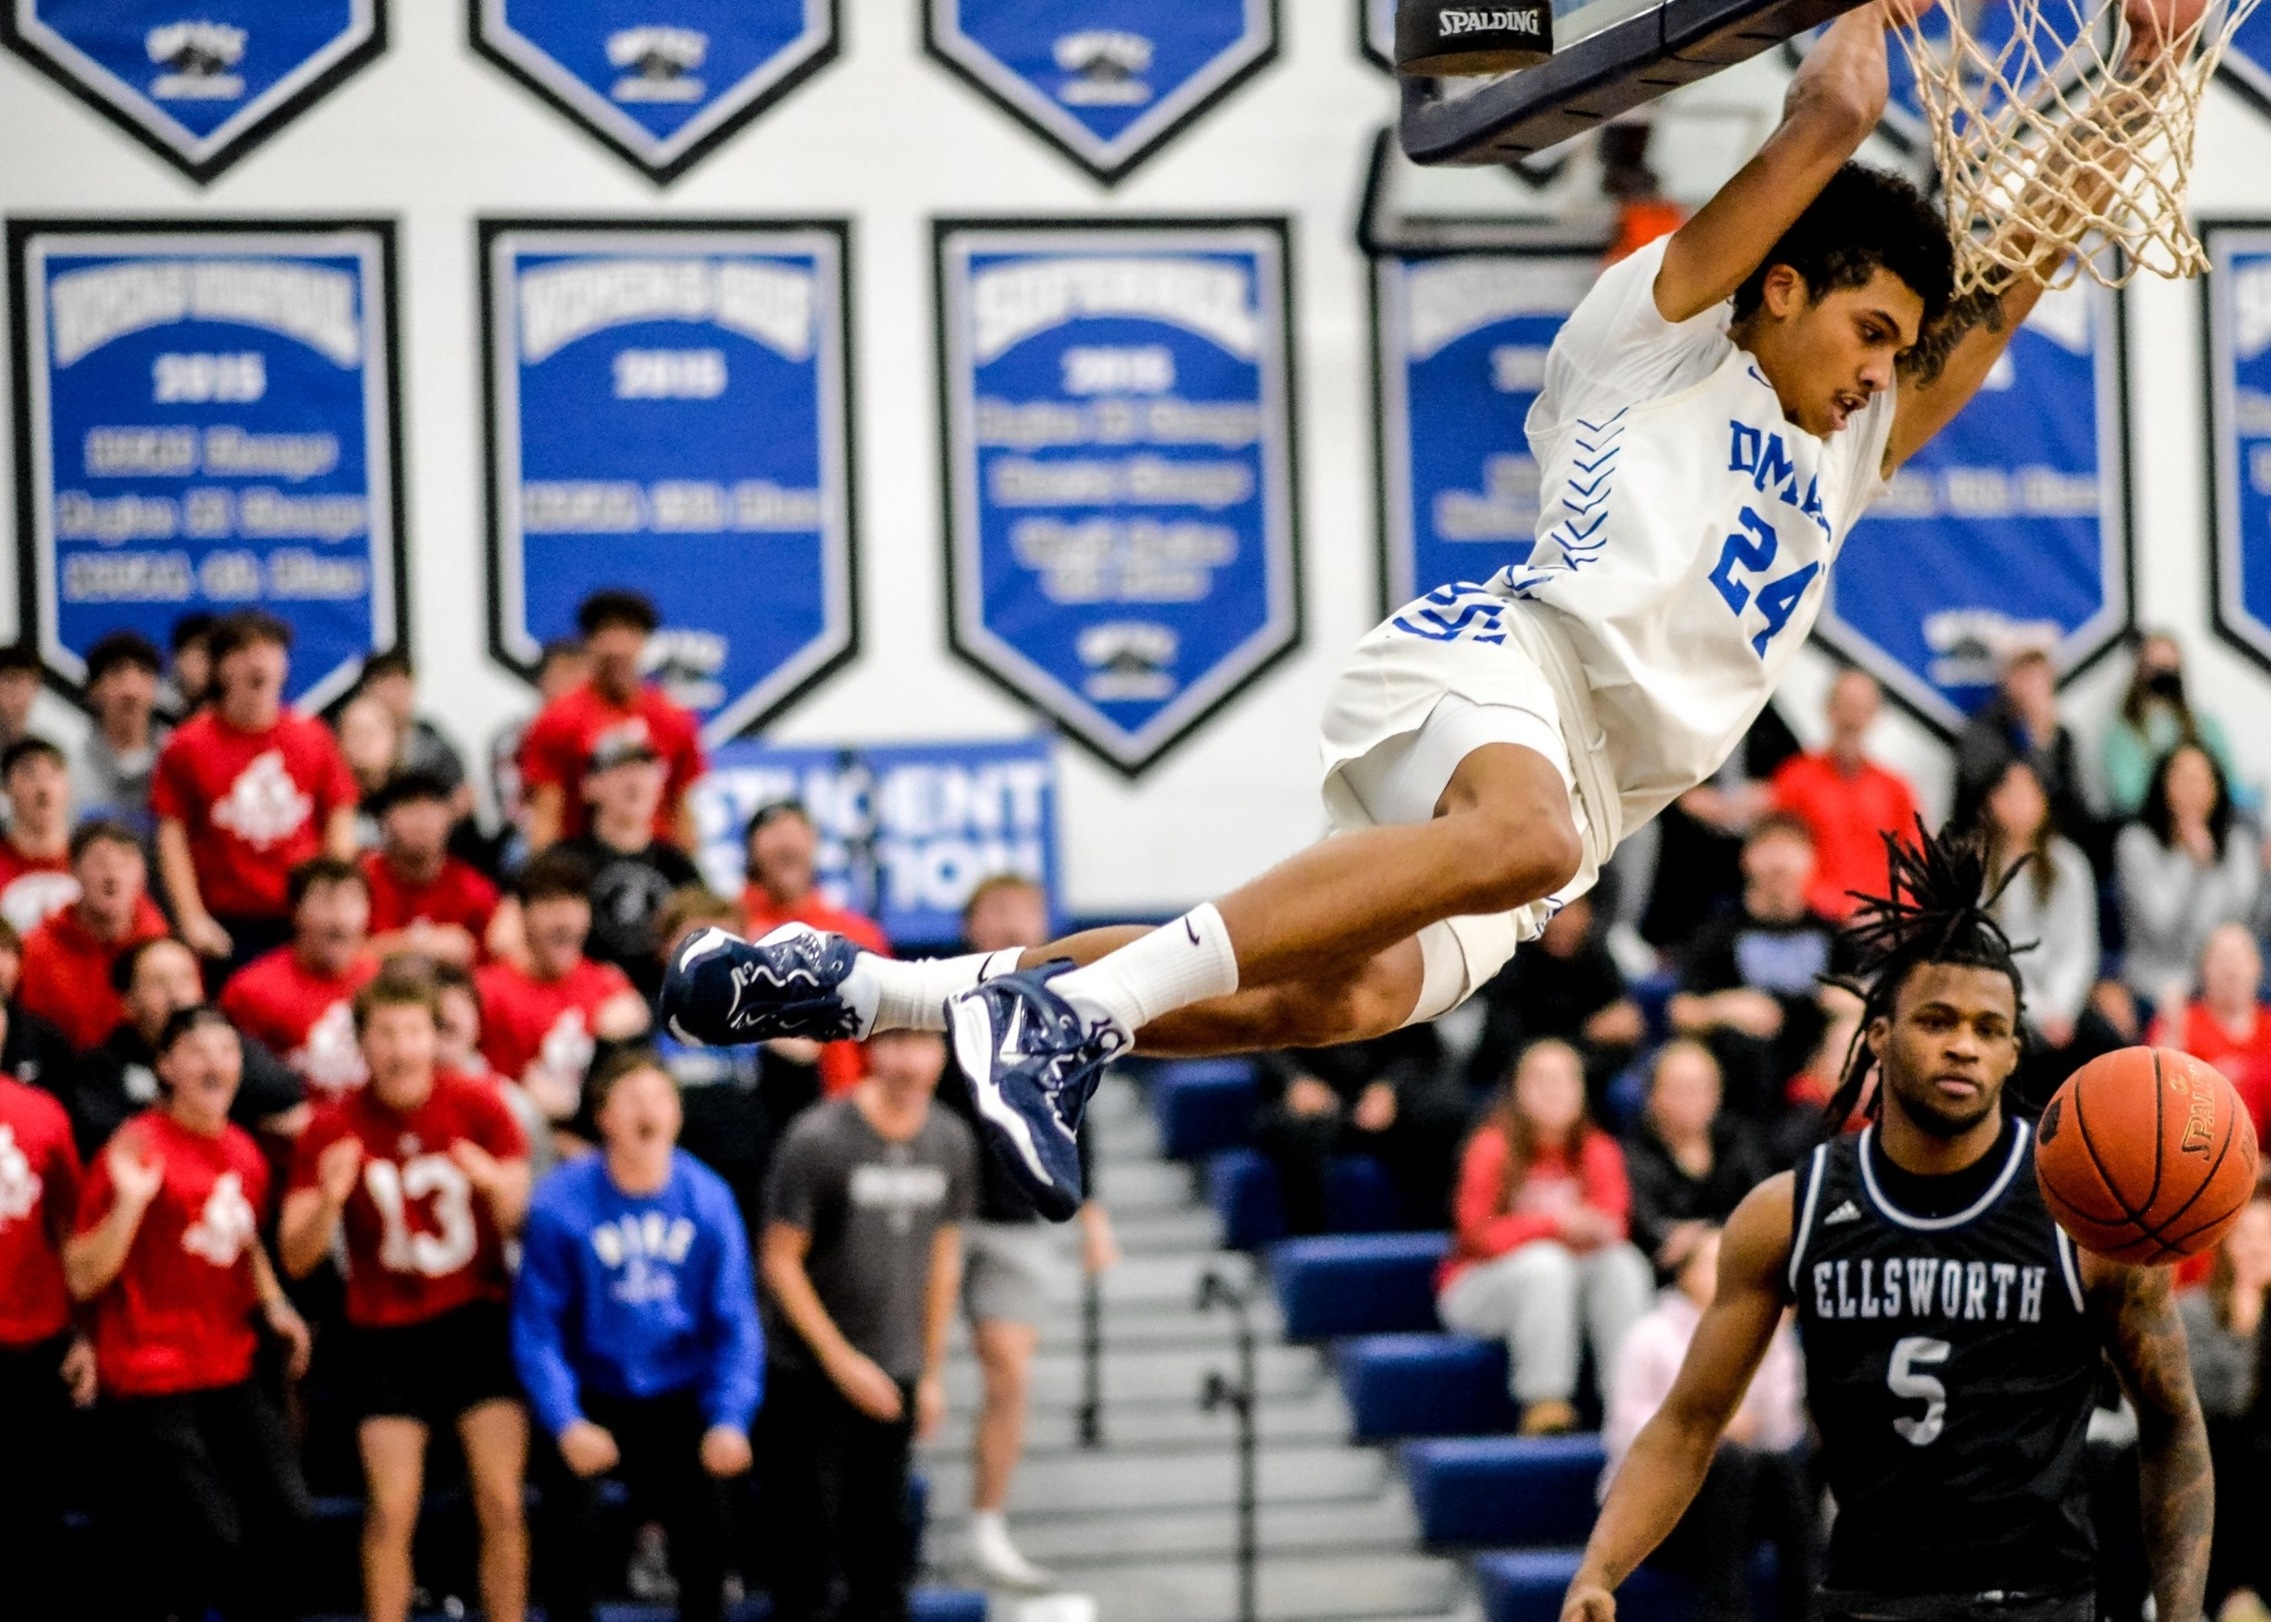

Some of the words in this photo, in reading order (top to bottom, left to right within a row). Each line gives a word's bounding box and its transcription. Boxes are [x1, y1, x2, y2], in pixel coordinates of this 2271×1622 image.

[1439, 9, 1540, 36] SPALDING
[1708, 505, 1819, 661] 24
[364, 1154, 479, 1278] 13
[1813, 1257, 2046, 1323] ELLSWORTH
[1886, 1336, 1951, 1446] 5
